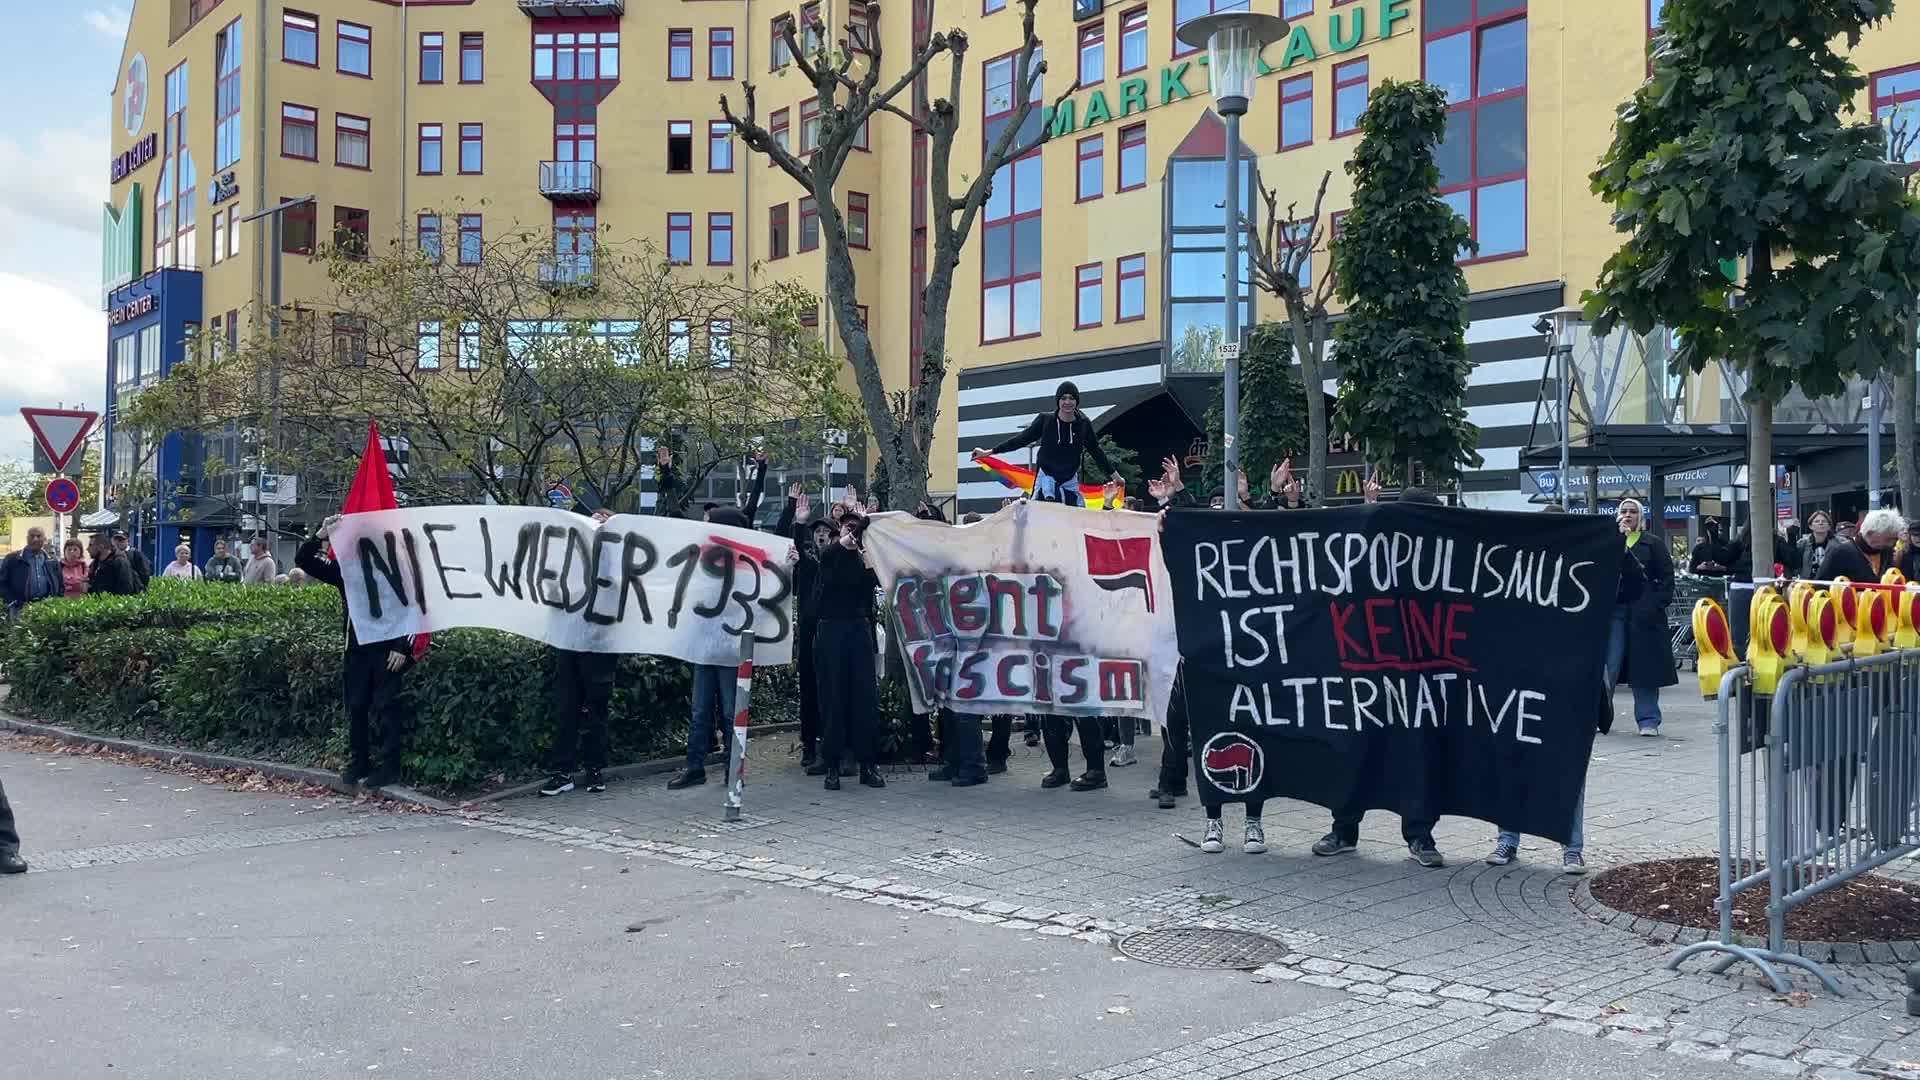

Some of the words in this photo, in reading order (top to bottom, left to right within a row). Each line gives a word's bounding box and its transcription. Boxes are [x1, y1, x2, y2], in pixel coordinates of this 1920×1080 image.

[1043, 0, 1409, 137] MARKAUF
[126, 294, 153, 320] CENTER
[1219, 344, 1237, 353] 1532
[1582, 475, 1622, 486] Wstern
[358, 521, 483, 620] NIE
[479, 516, 659, 625] WIEDER
[665, 541, 792, 644] 1933
[1194, 531, 1596, 613] RECHTSPOPULISMUS
[1220, 604, 1294, 668] IST
[1329, 598, 1474, 662] KEINE
[912, 644, 1143, 705] fascism
[1229, 672, 1547, 745] ALTERNATIVE
